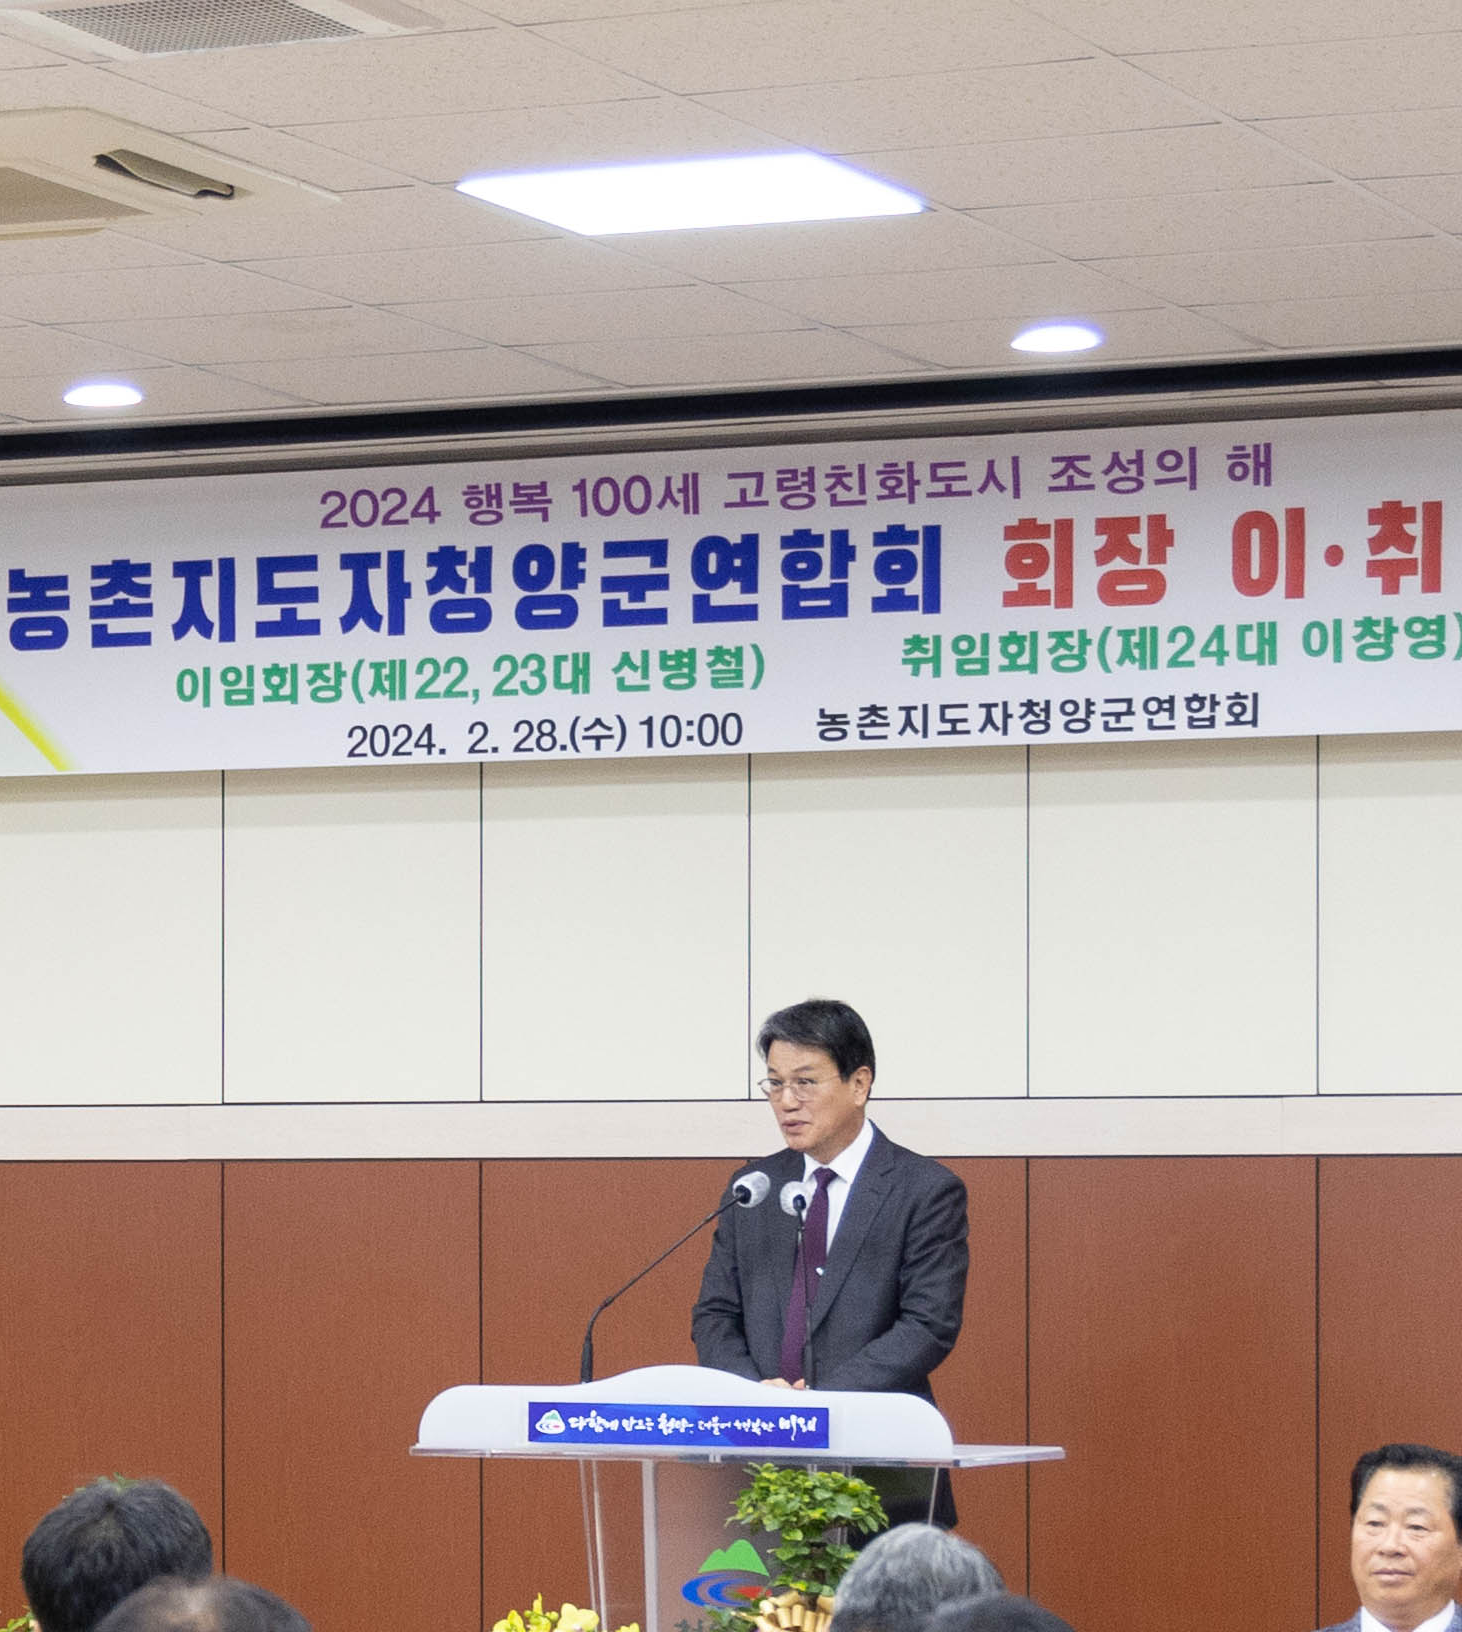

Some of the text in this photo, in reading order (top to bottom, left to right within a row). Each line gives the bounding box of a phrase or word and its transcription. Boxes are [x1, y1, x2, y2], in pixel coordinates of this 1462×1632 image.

[319, 441, 1275, 530] 2024 행복 100세 고령친화도시 조성의 해
[6, 523, 943, 652] 농촌지도자청양군연합회
[1002, 513, 1176, 610] 회장
[611, 643, 767, 694] 신병철)
[900, 620, 1279, 679] 취임회장(제24대
[346, 723, 447, 759] 2024.
[639, 712, 745, 749] 10:00
[815, 692, 1260, 743] 농촌지도자청양군연합회
